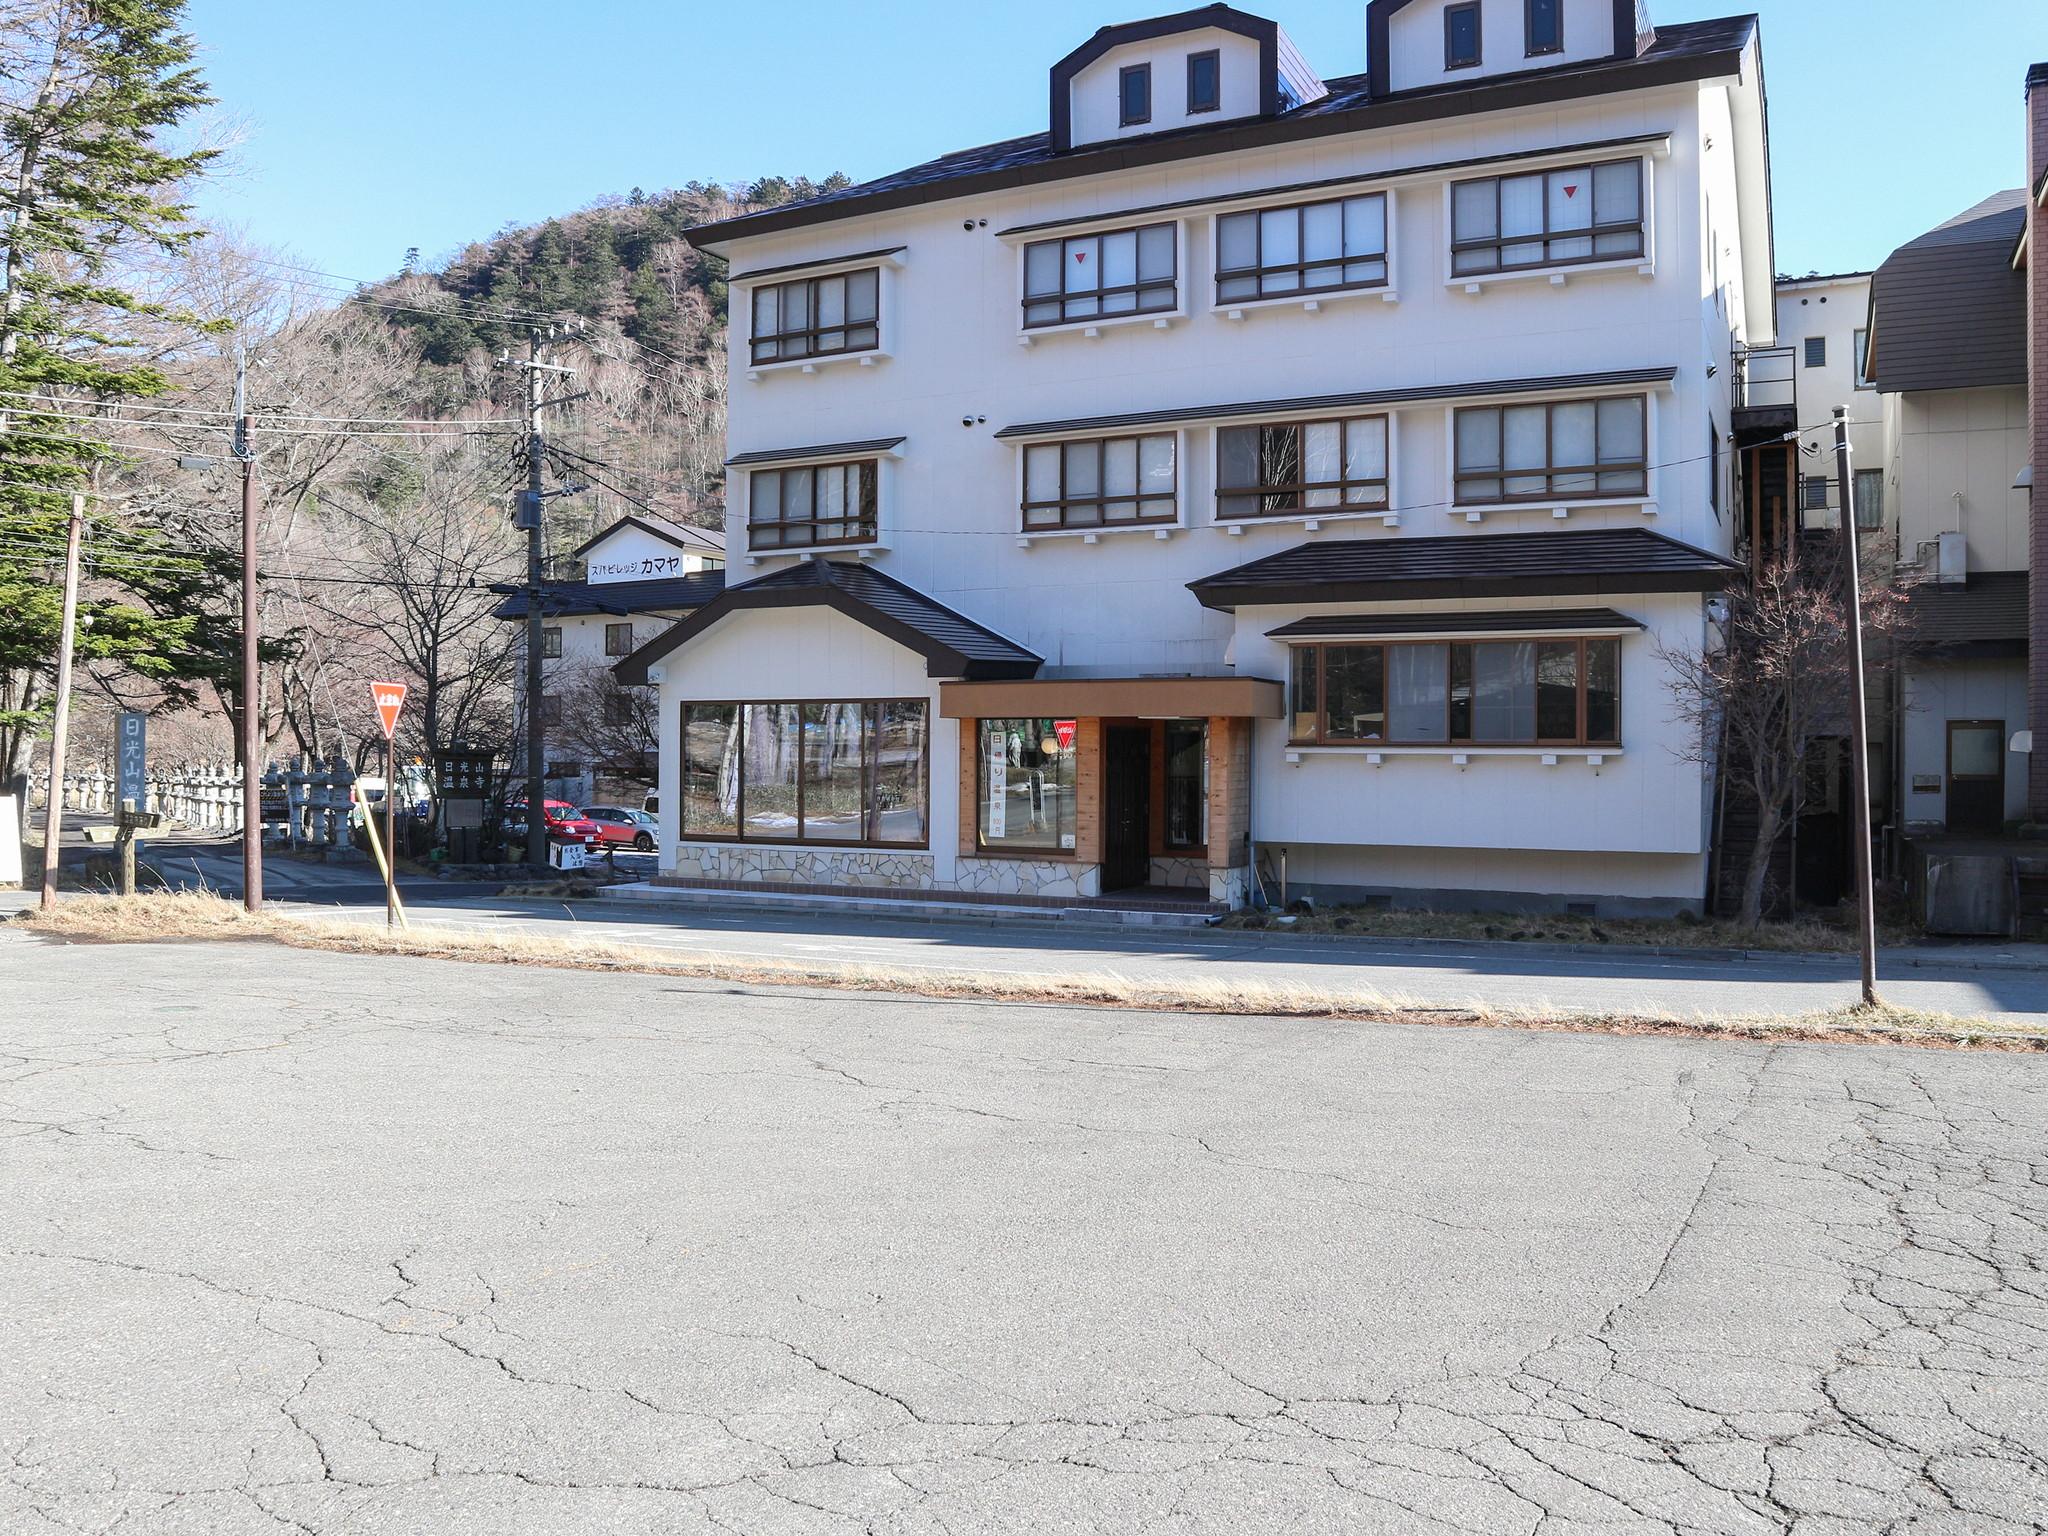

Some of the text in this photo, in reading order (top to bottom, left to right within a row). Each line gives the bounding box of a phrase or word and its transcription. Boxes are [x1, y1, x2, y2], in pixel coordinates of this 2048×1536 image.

[591, 556, 680, 576] スパビレッジ カマヤ
[125, 718, 141, 809] 日光山温
[445, 761, 484, 773] 日光山
[443, 775, 485, 789] 温泉寺
